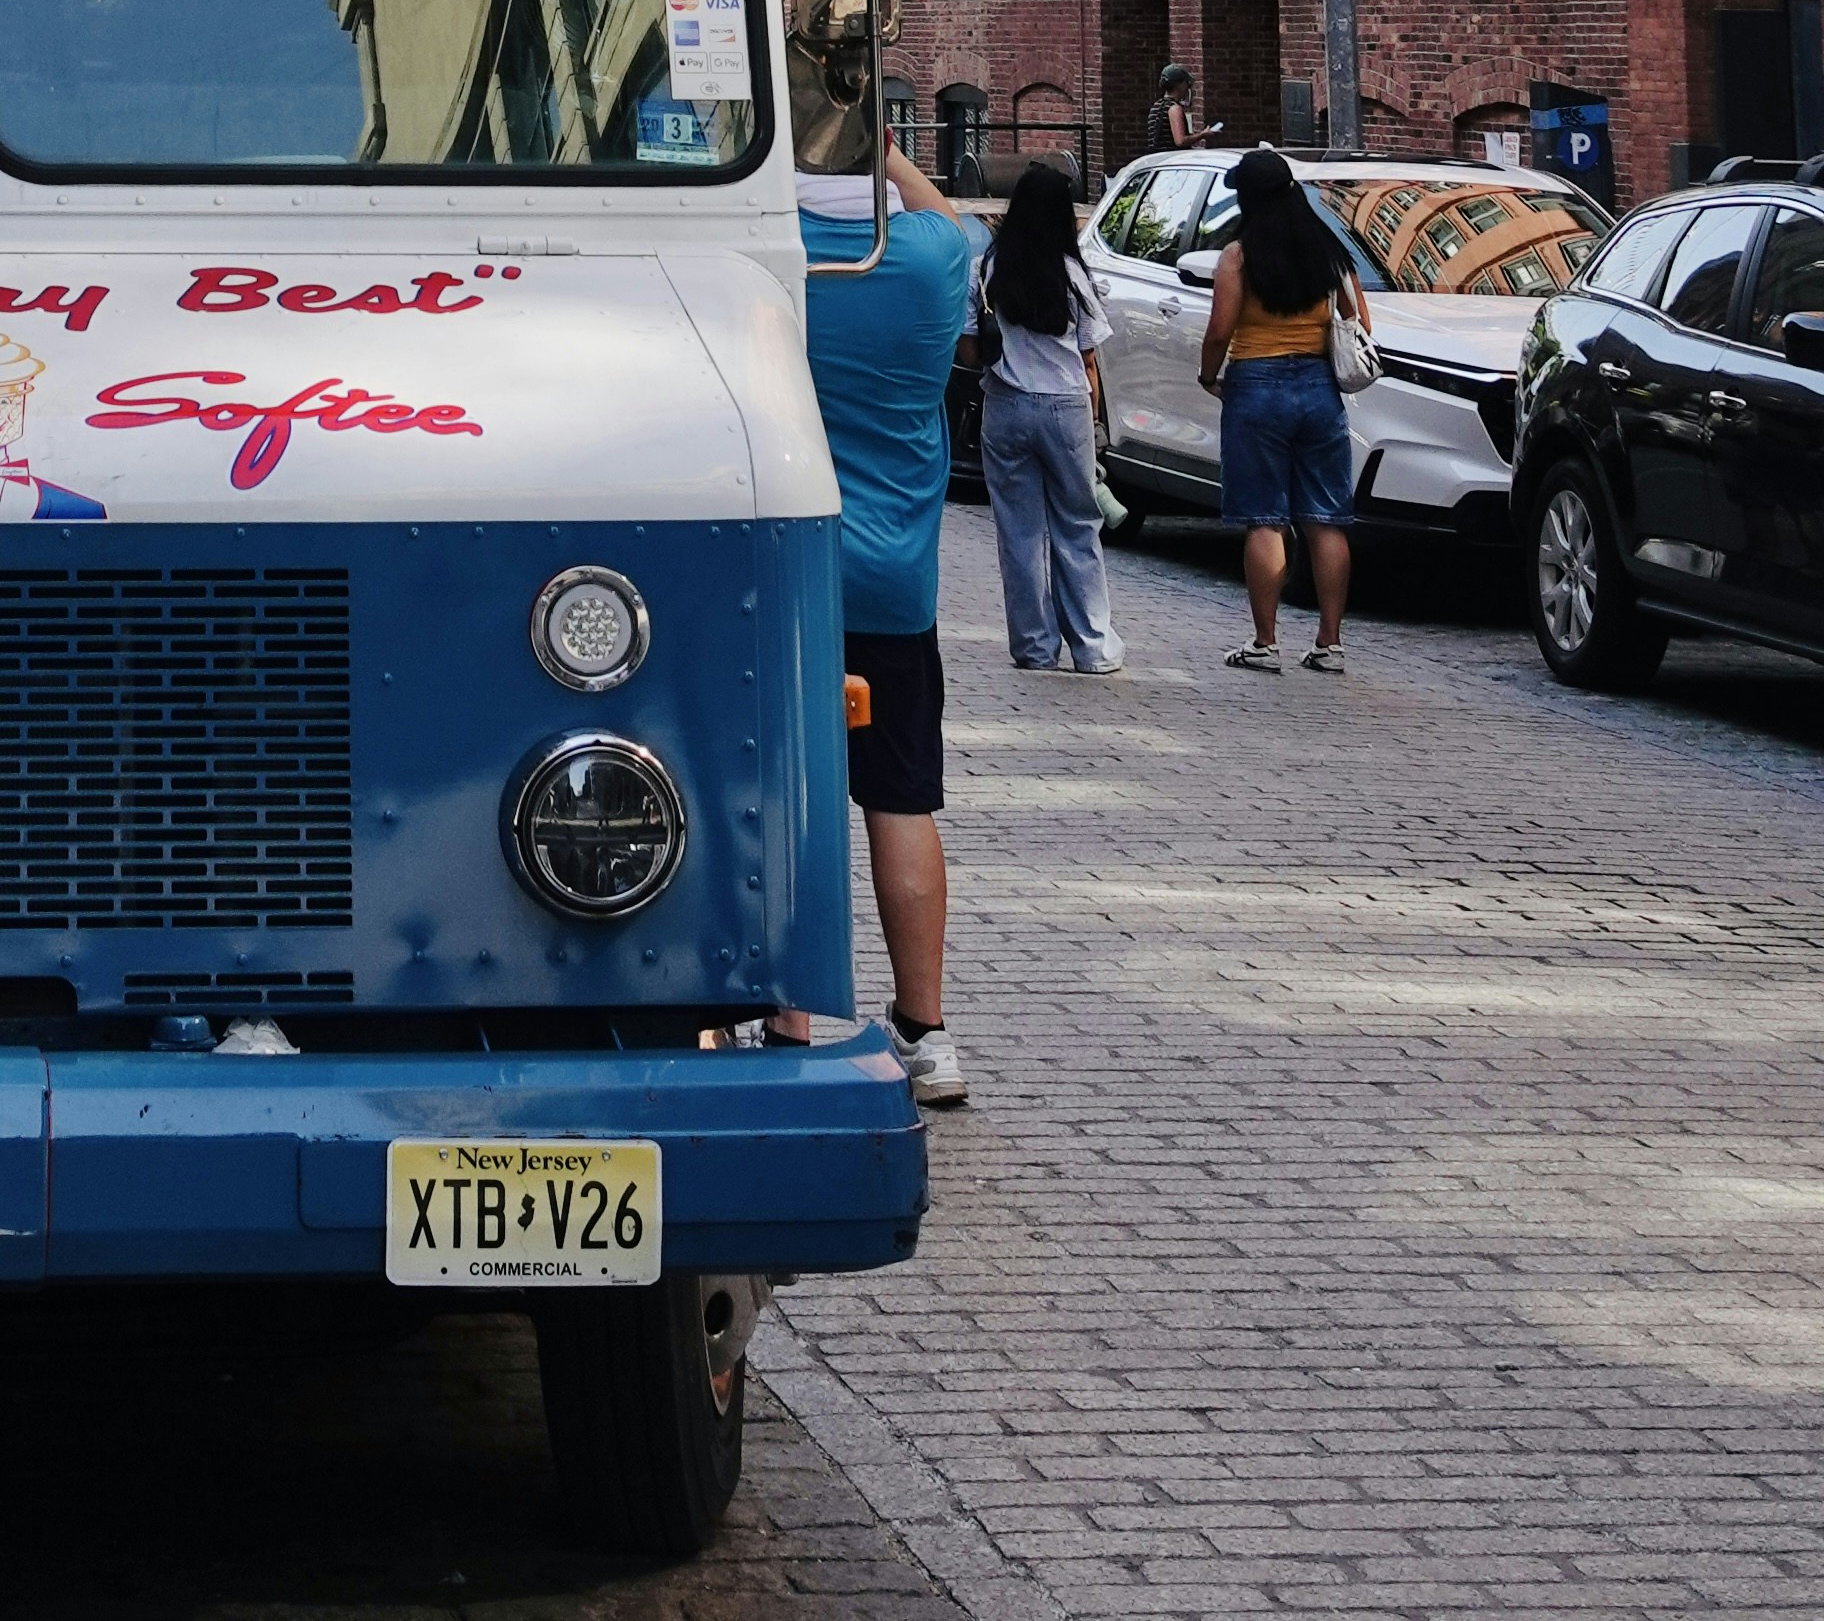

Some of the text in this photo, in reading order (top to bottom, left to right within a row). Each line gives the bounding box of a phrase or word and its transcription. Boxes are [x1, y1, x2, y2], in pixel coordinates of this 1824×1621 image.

[687, 58, 703, 68] Pay
[671, 117, 681, 140] 3
[1570, 132, 1592, 165] P
[176, 264, 522, 315] Best"
[84, 370, 484, 491] Softee
[456, 1147, 592, 1176] New Jersey
[409, 1178, 643, 1250] XTB V26
[469, 1262, 582, 1276] COMMERCIAL
